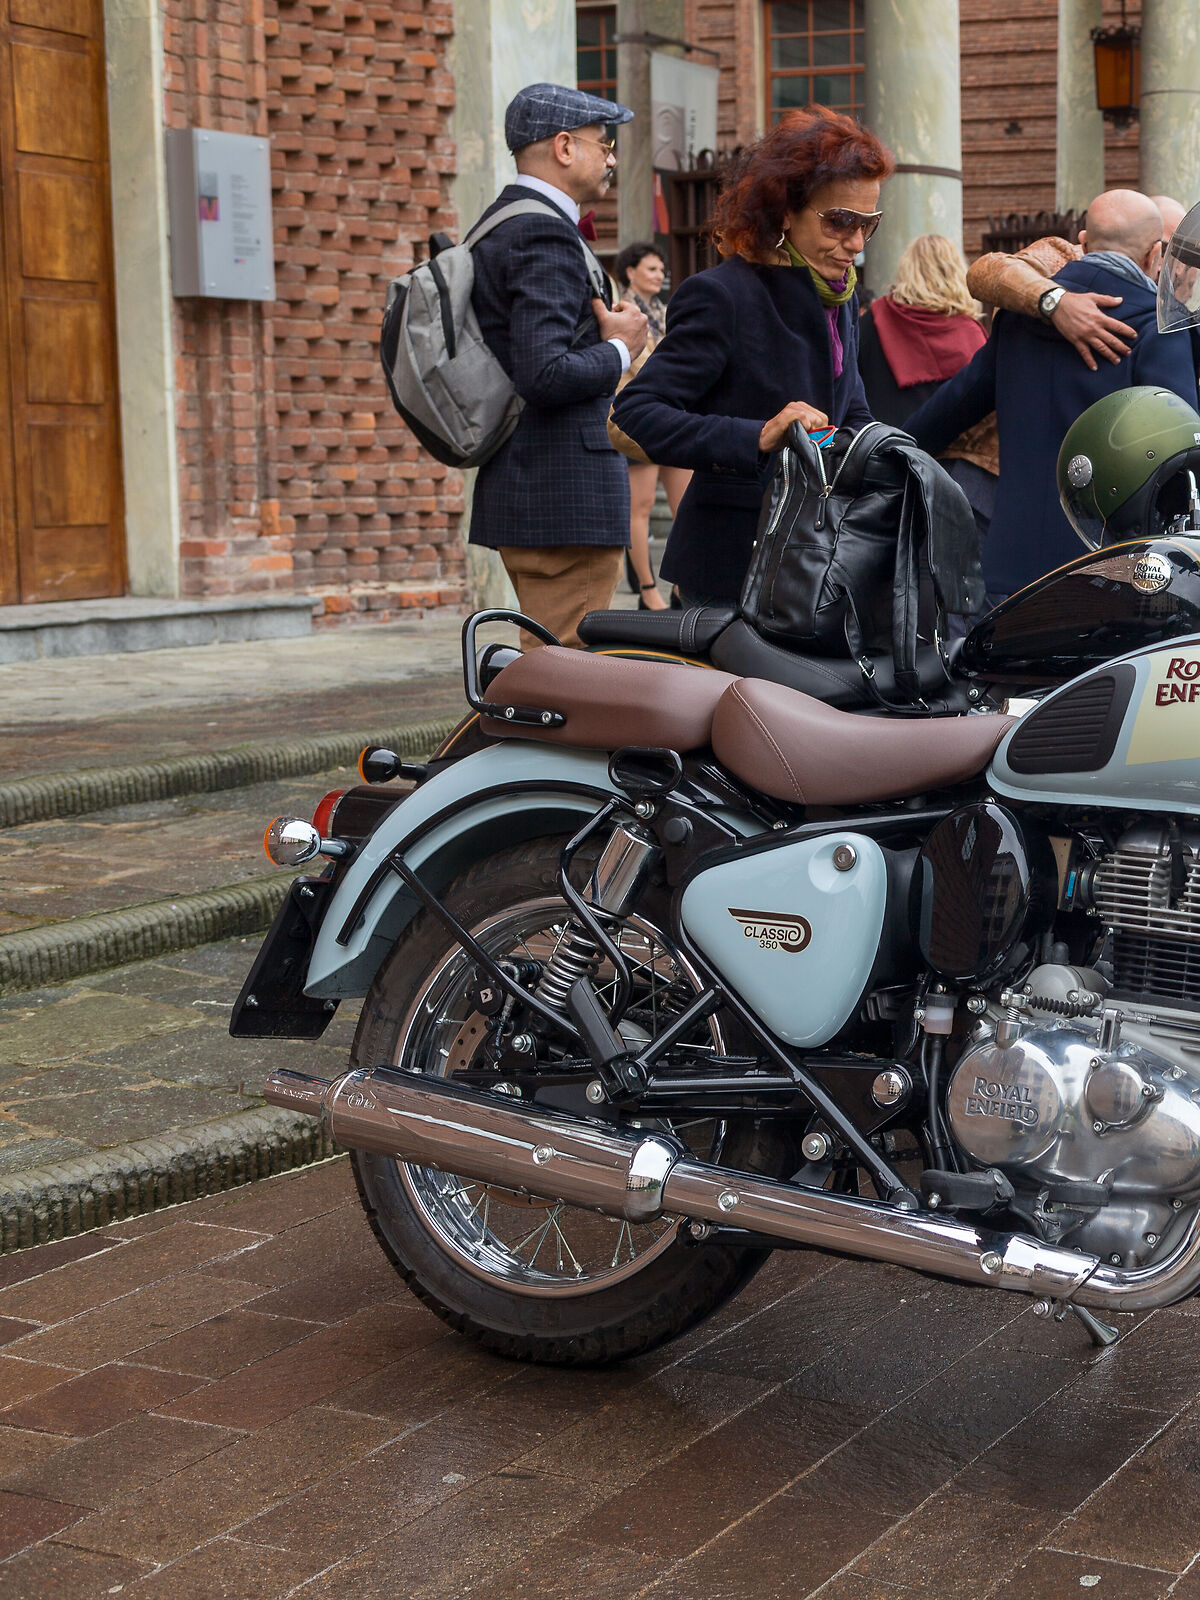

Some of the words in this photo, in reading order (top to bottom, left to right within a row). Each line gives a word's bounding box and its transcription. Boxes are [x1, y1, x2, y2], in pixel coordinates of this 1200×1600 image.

[1136, 562, 1162, 573] ROYAL
[1133, 571, 1166, 582] ENFIELD
[744, 925, 801, 942] CLASSIC
[759, 939, 778, 950] 350
[973, 1076, 1032, 1105] ROYAL
[965, 1096, 1039, 1127] ENFIELD
